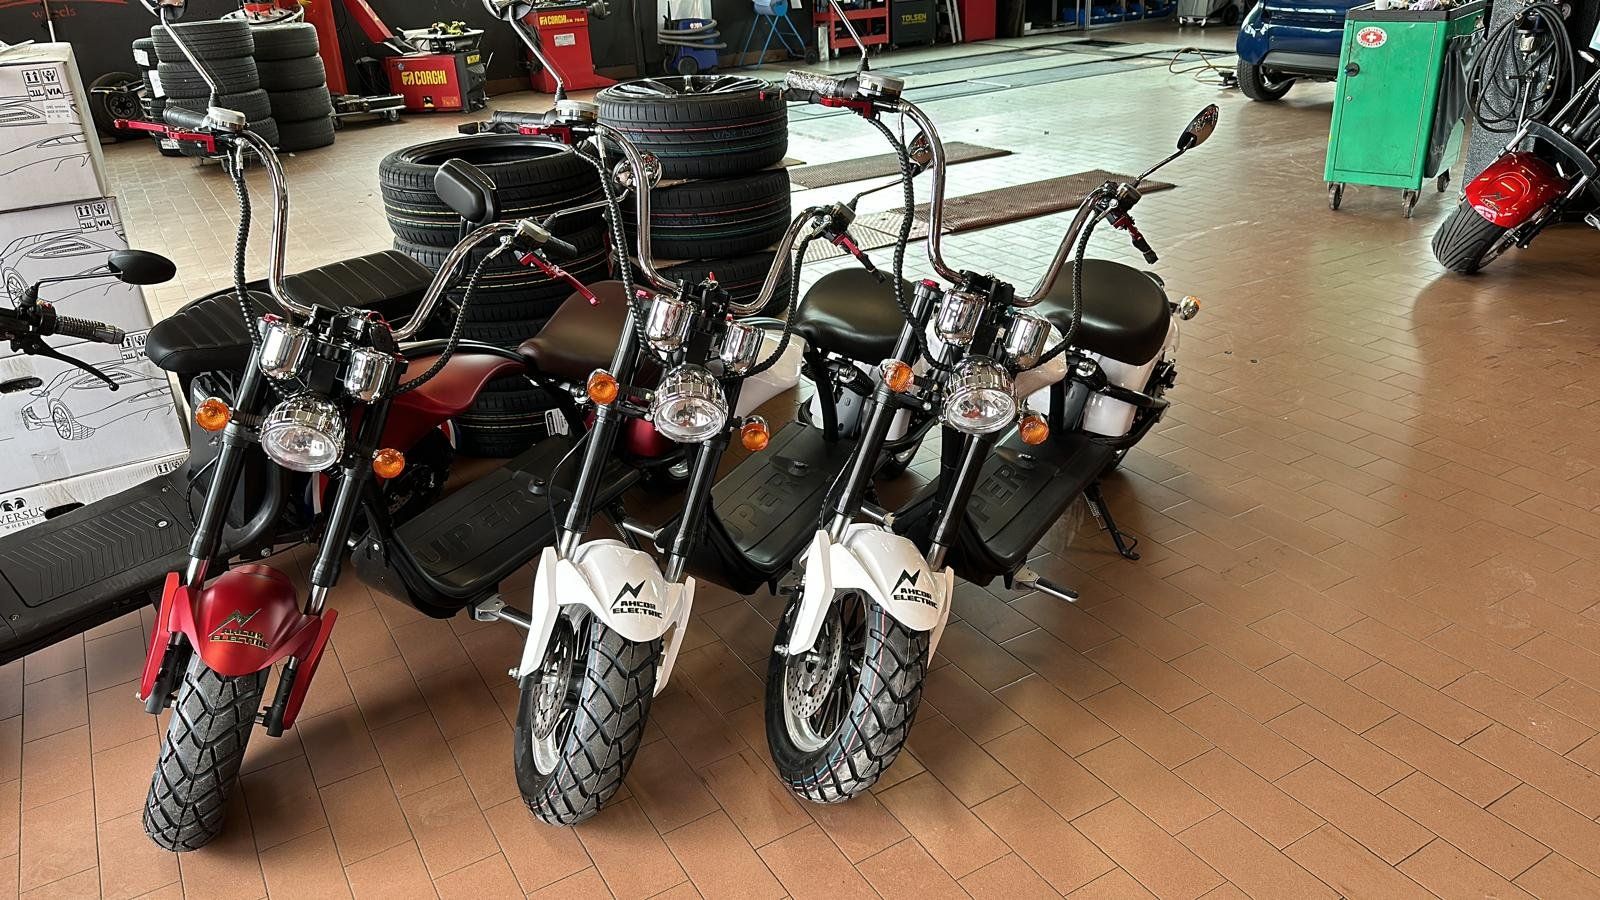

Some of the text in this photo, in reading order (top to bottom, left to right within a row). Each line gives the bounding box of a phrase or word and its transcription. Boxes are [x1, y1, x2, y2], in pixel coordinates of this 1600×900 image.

[414, 70, 447, 84] CORGHI
[47, 87, 62, 96] VIA
[97, 219, 112, 227] VIA
[893, 594, 938, 610] ELECTRIC
[612, 607, 663, 619] ELECTRIC
